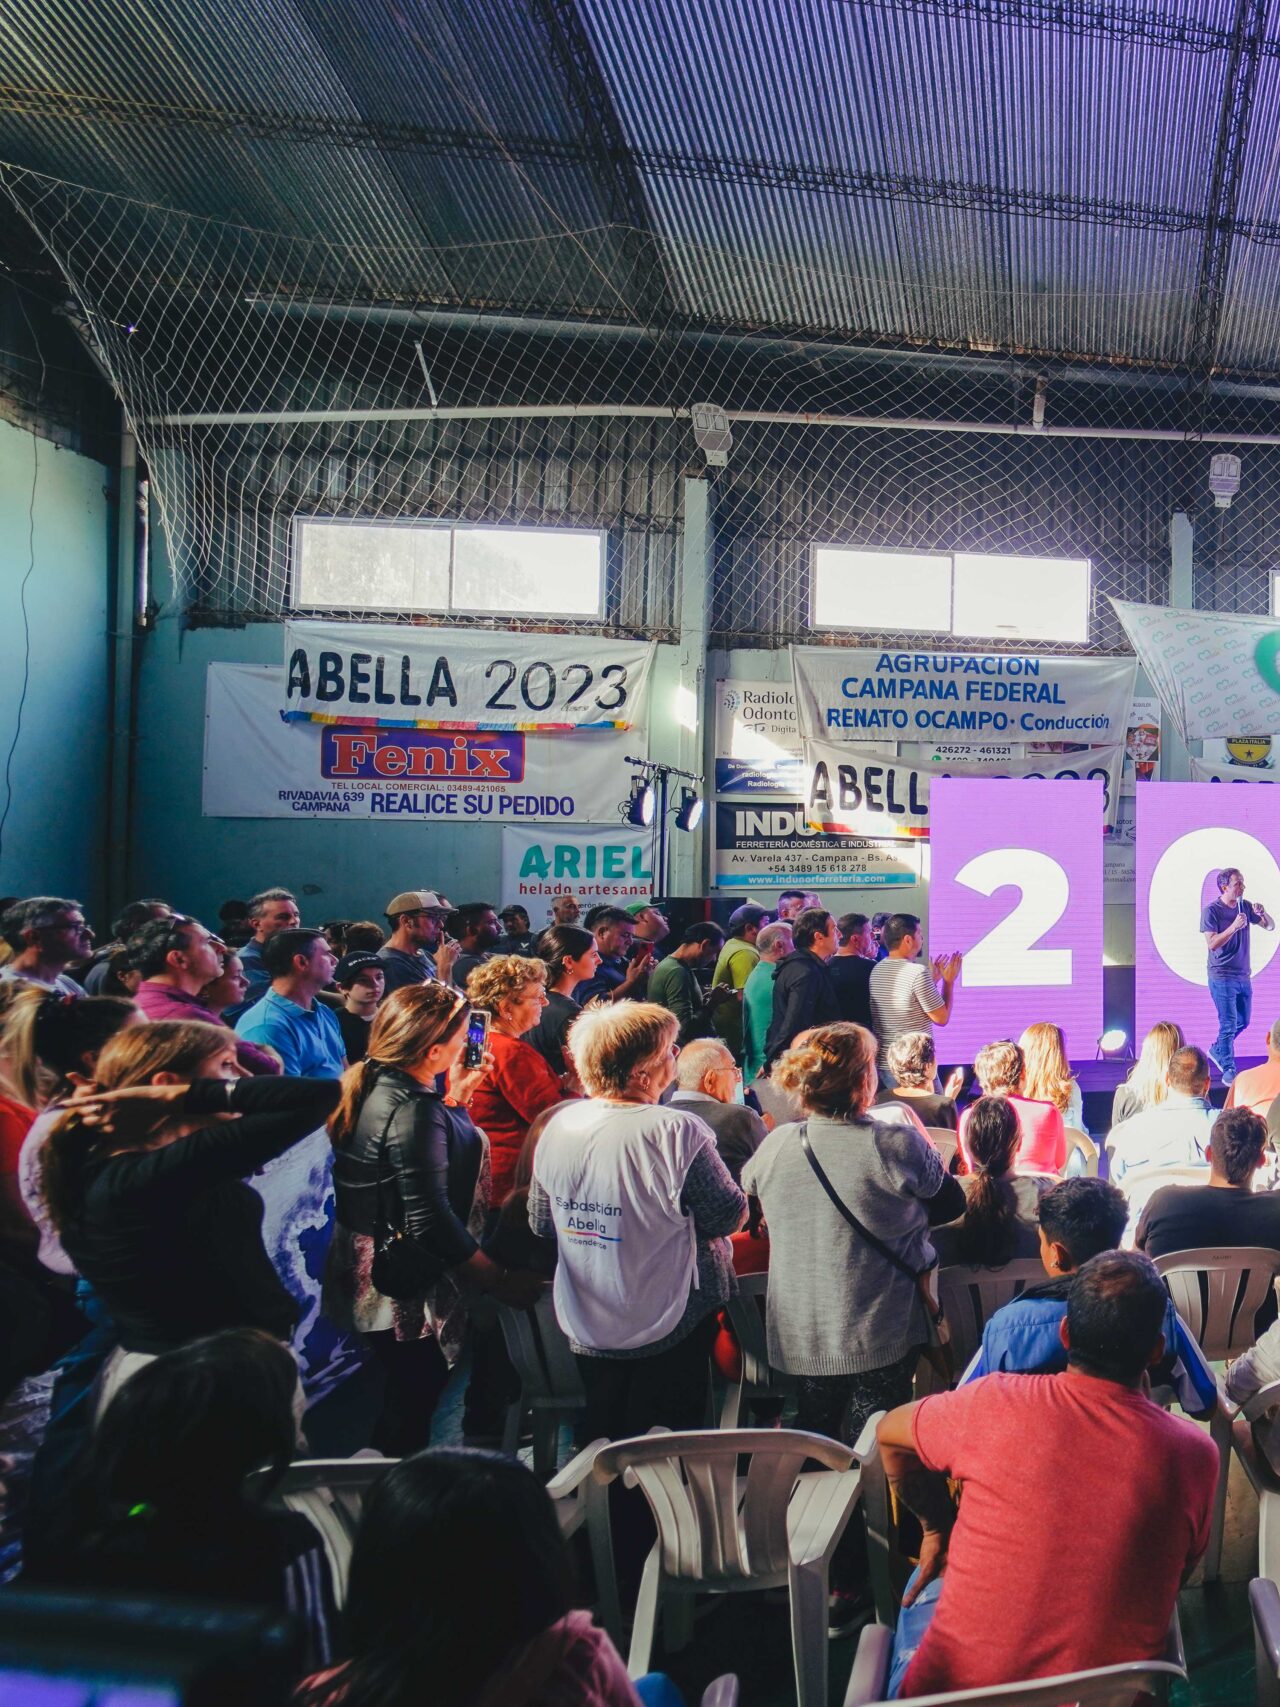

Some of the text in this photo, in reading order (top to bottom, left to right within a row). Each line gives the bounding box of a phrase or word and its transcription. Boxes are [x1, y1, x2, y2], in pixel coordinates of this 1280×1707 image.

[287, 648, 628, 712] ABELLA 2023
[841, 676, 1066, 705] CAMPANA FEDERAL
[826, 707, 909, 729] RENATO
[331, 735, 510, 778] Fenix
[935, 746, 971, 754] 426272
[979, 746, 1011, 755] 461321
[278, 790, 365, 802] RIVADAVIA 639
[331, 782, 507, 793] TEL LOCAL COMERCIAL: 03489-421065
[810, 760, 952, 816] ABELL
[292, 801, 351, 812] CAMPANA
[370, 791, 575, 816] REALICE SU PEDIDO
[840, 839, 847, 848] E
[519, 844, 653, 880] ARIEL
[731, 854, 748, 863] Av.
[750, 853, 782, 862] Varela
[784, 853, 803, 862] 437
[811, 853, 858, 863] Campana
[867, 853, 883, 862] Bs.
[767, 863, 867, 873] +54 3489 15 618 278
[519, 882, 573, 895] helado
[555, 1196, 622, 1217] Sebastián
[567, 1216, 607, 1234] Abella
